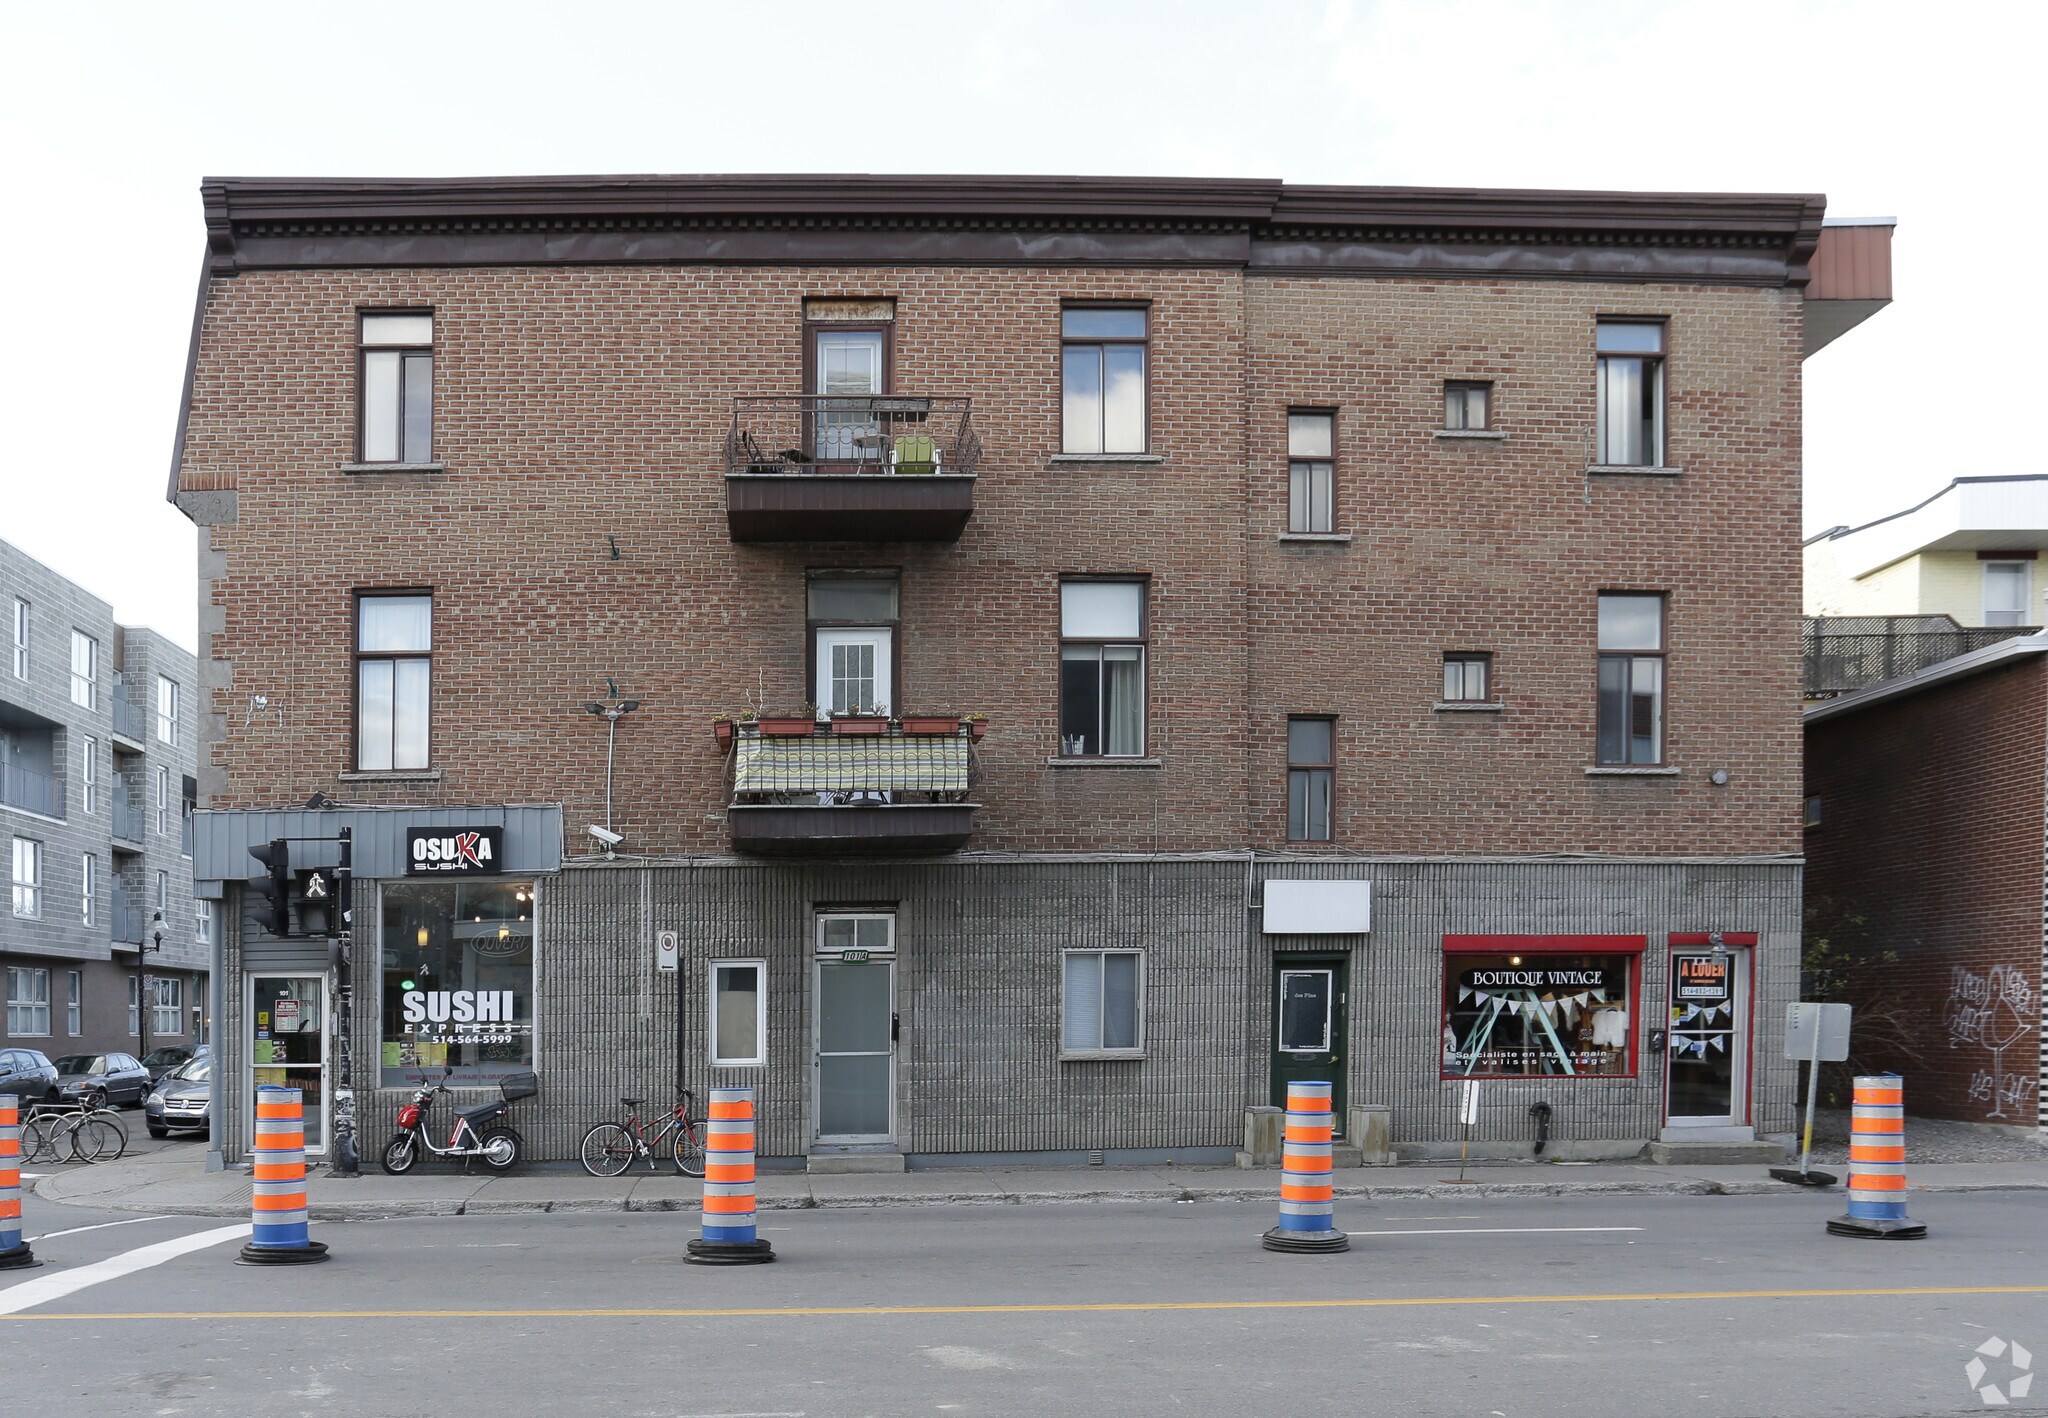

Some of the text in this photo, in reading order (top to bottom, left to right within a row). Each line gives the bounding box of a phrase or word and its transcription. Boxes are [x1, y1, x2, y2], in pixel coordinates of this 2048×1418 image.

[413, 831, 492, 868] OSUKA
[476, 935, 527, 950] OUVERT
[1691, 962, 1725, 977] LOUER
[1473, 971, 1602, 986] BOUTIQUE VINTAGE
[403, 990, 513, 1022] SUSHI
[404, 1023, 512, 1034] EXPRESS
[432, 1035, 512, 1044] 514-564-5999
